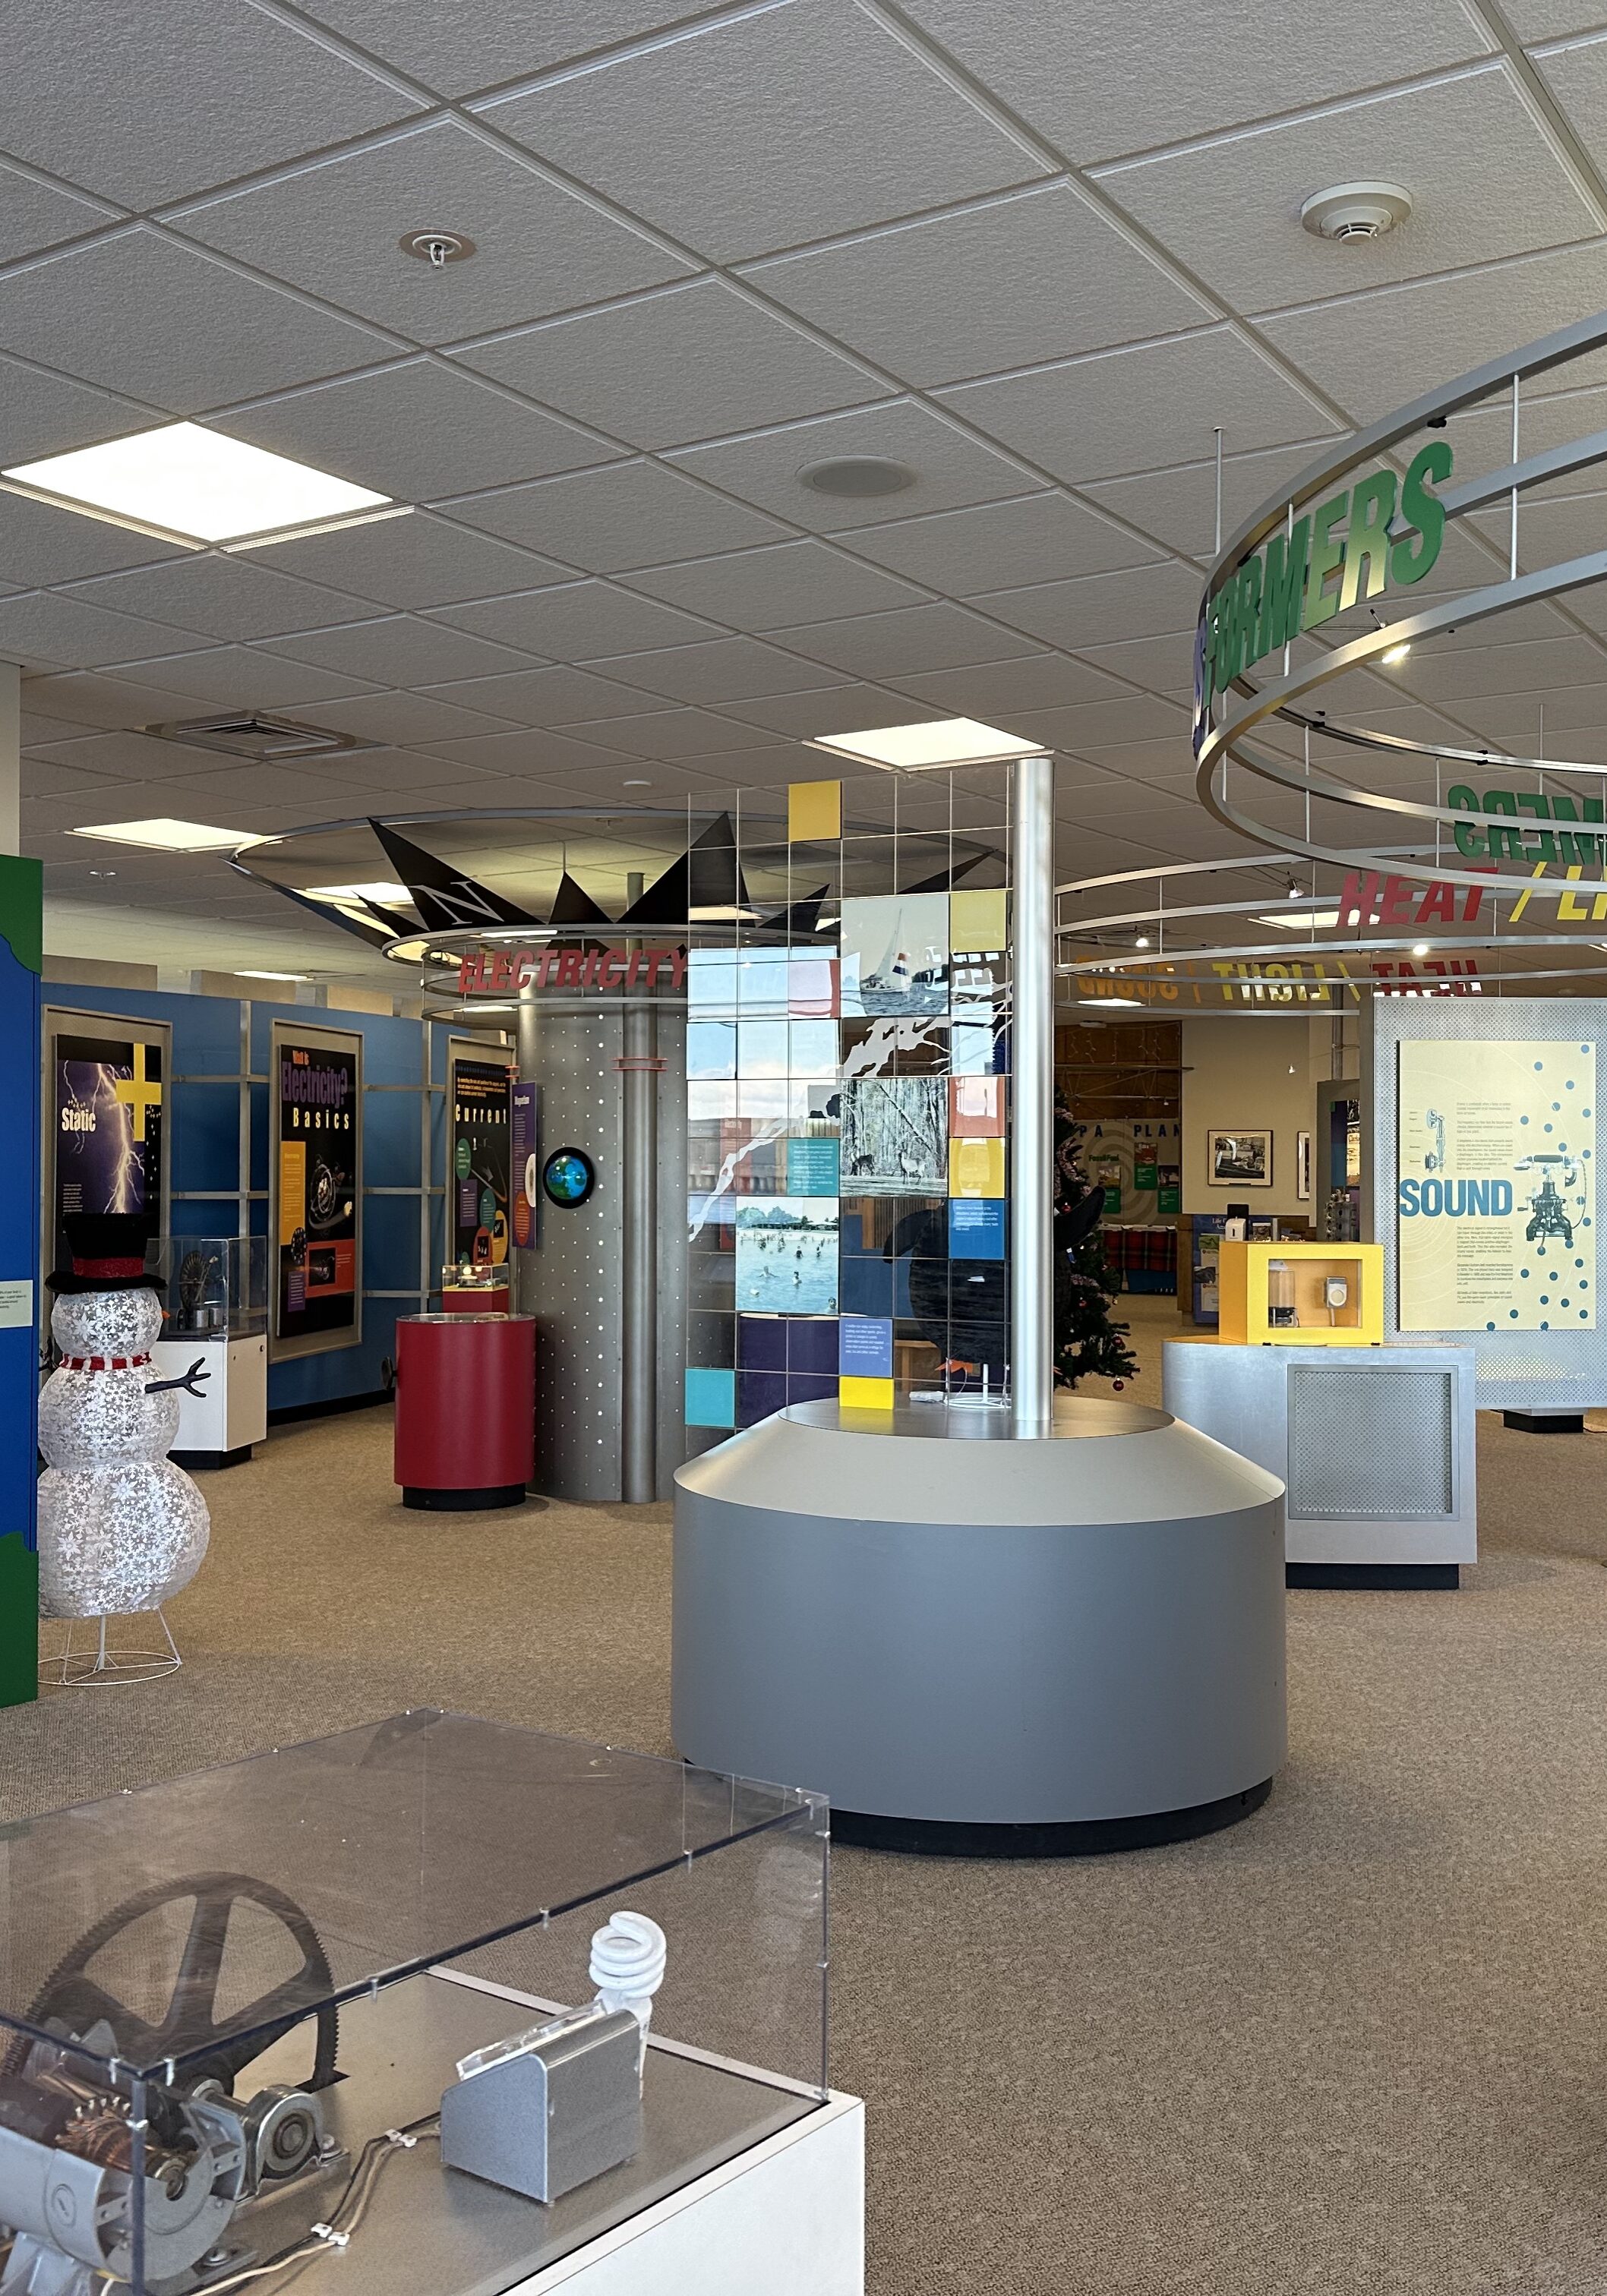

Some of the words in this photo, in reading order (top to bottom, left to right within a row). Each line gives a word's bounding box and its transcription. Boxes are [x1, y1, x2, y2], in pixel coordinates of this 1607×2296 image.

[1338, 866, 1499, 928] HEAT
[459, 948, 687, 993] ELECTRICITY
[282, 1061, 348, 1109] Electricity?
[62, 1107, 96, 1132] Static
[292, 1107, 349, 1130] Basics
[456, 1104, 507, 1124] Current
[1400, 1178, 1513, 1217] SOUND
